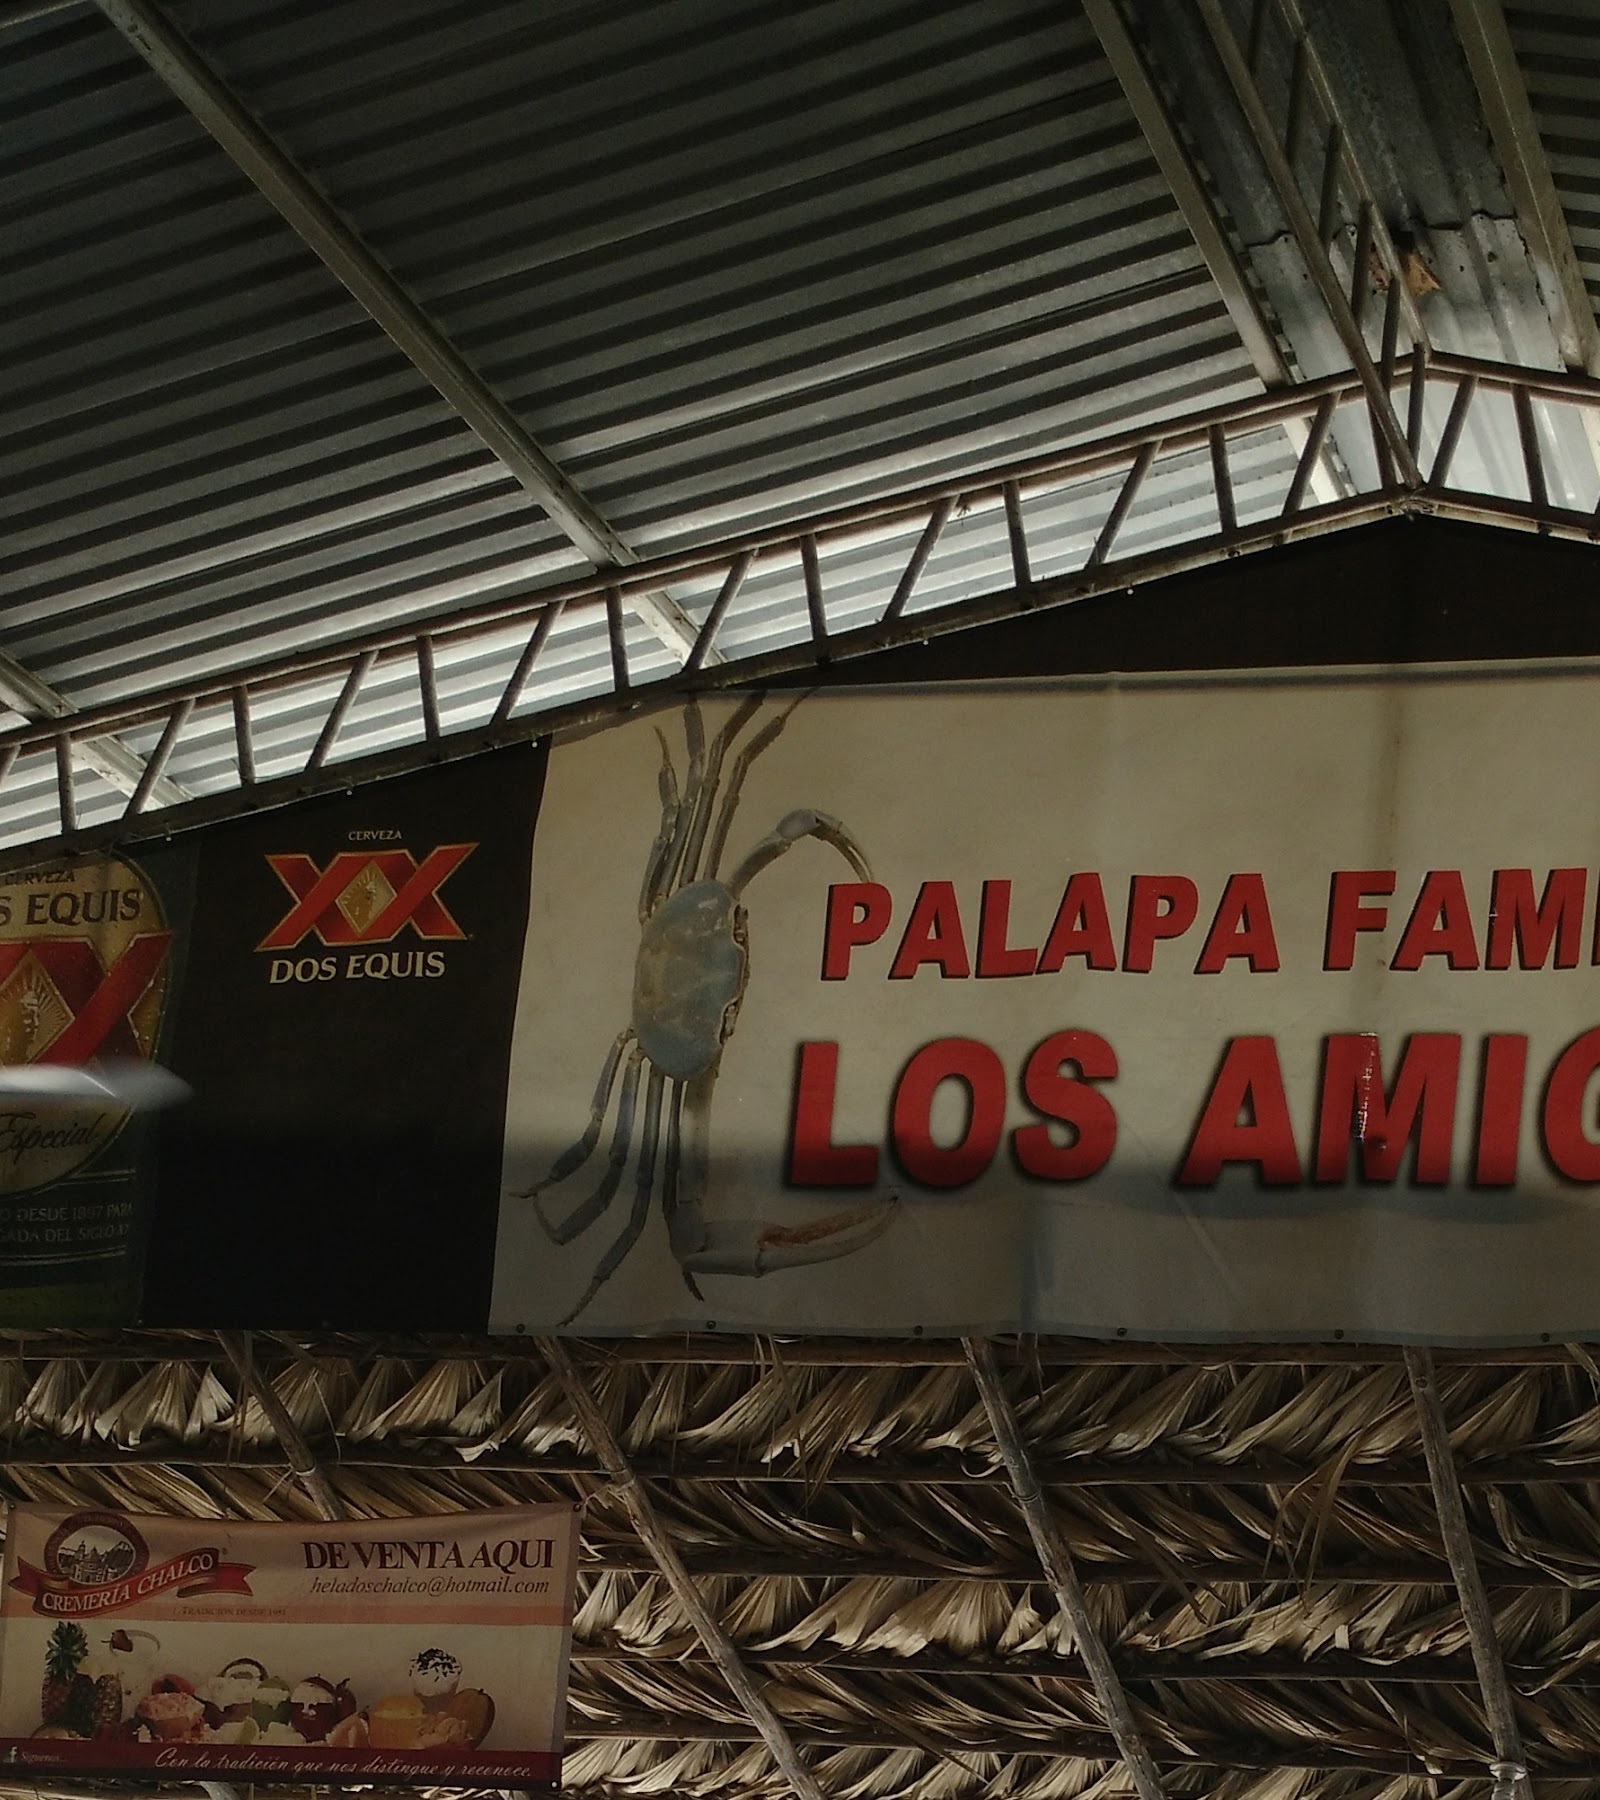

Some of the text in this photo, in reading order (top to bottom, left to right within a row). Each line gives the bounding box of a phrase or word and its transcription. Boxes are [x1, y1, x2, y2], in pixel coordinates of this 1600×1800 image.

[348, 830, 403, 841] CERVEZA
[26, 889, 146, 926] EQUIS
[821, 872, 1280, 981] PALAPA
[269, 951, 446, 984] DOS EQUIS
[789, 1029, 1119, 1188] LOS
[17, 1207, 68, 1221] DESDE
[45, 1228, 72, 1242] DEL
[302, 1540, 555, 1574] DE VENTA AQUI
[42, 1553, 213, 1611] CREMERÍA CHALCO
[311, 1577, 549, 1597] heladoschalco@hotmail.com
[155, 1747, 188, 1768] Con
[191, 1751, 211, 1769] la
[293, 1760, 321, 1778] que
[327, 1761, 357, 1773] nos
[362, 1755, 436, 1782] distingue
[440, 1766, 457, 1783] y
